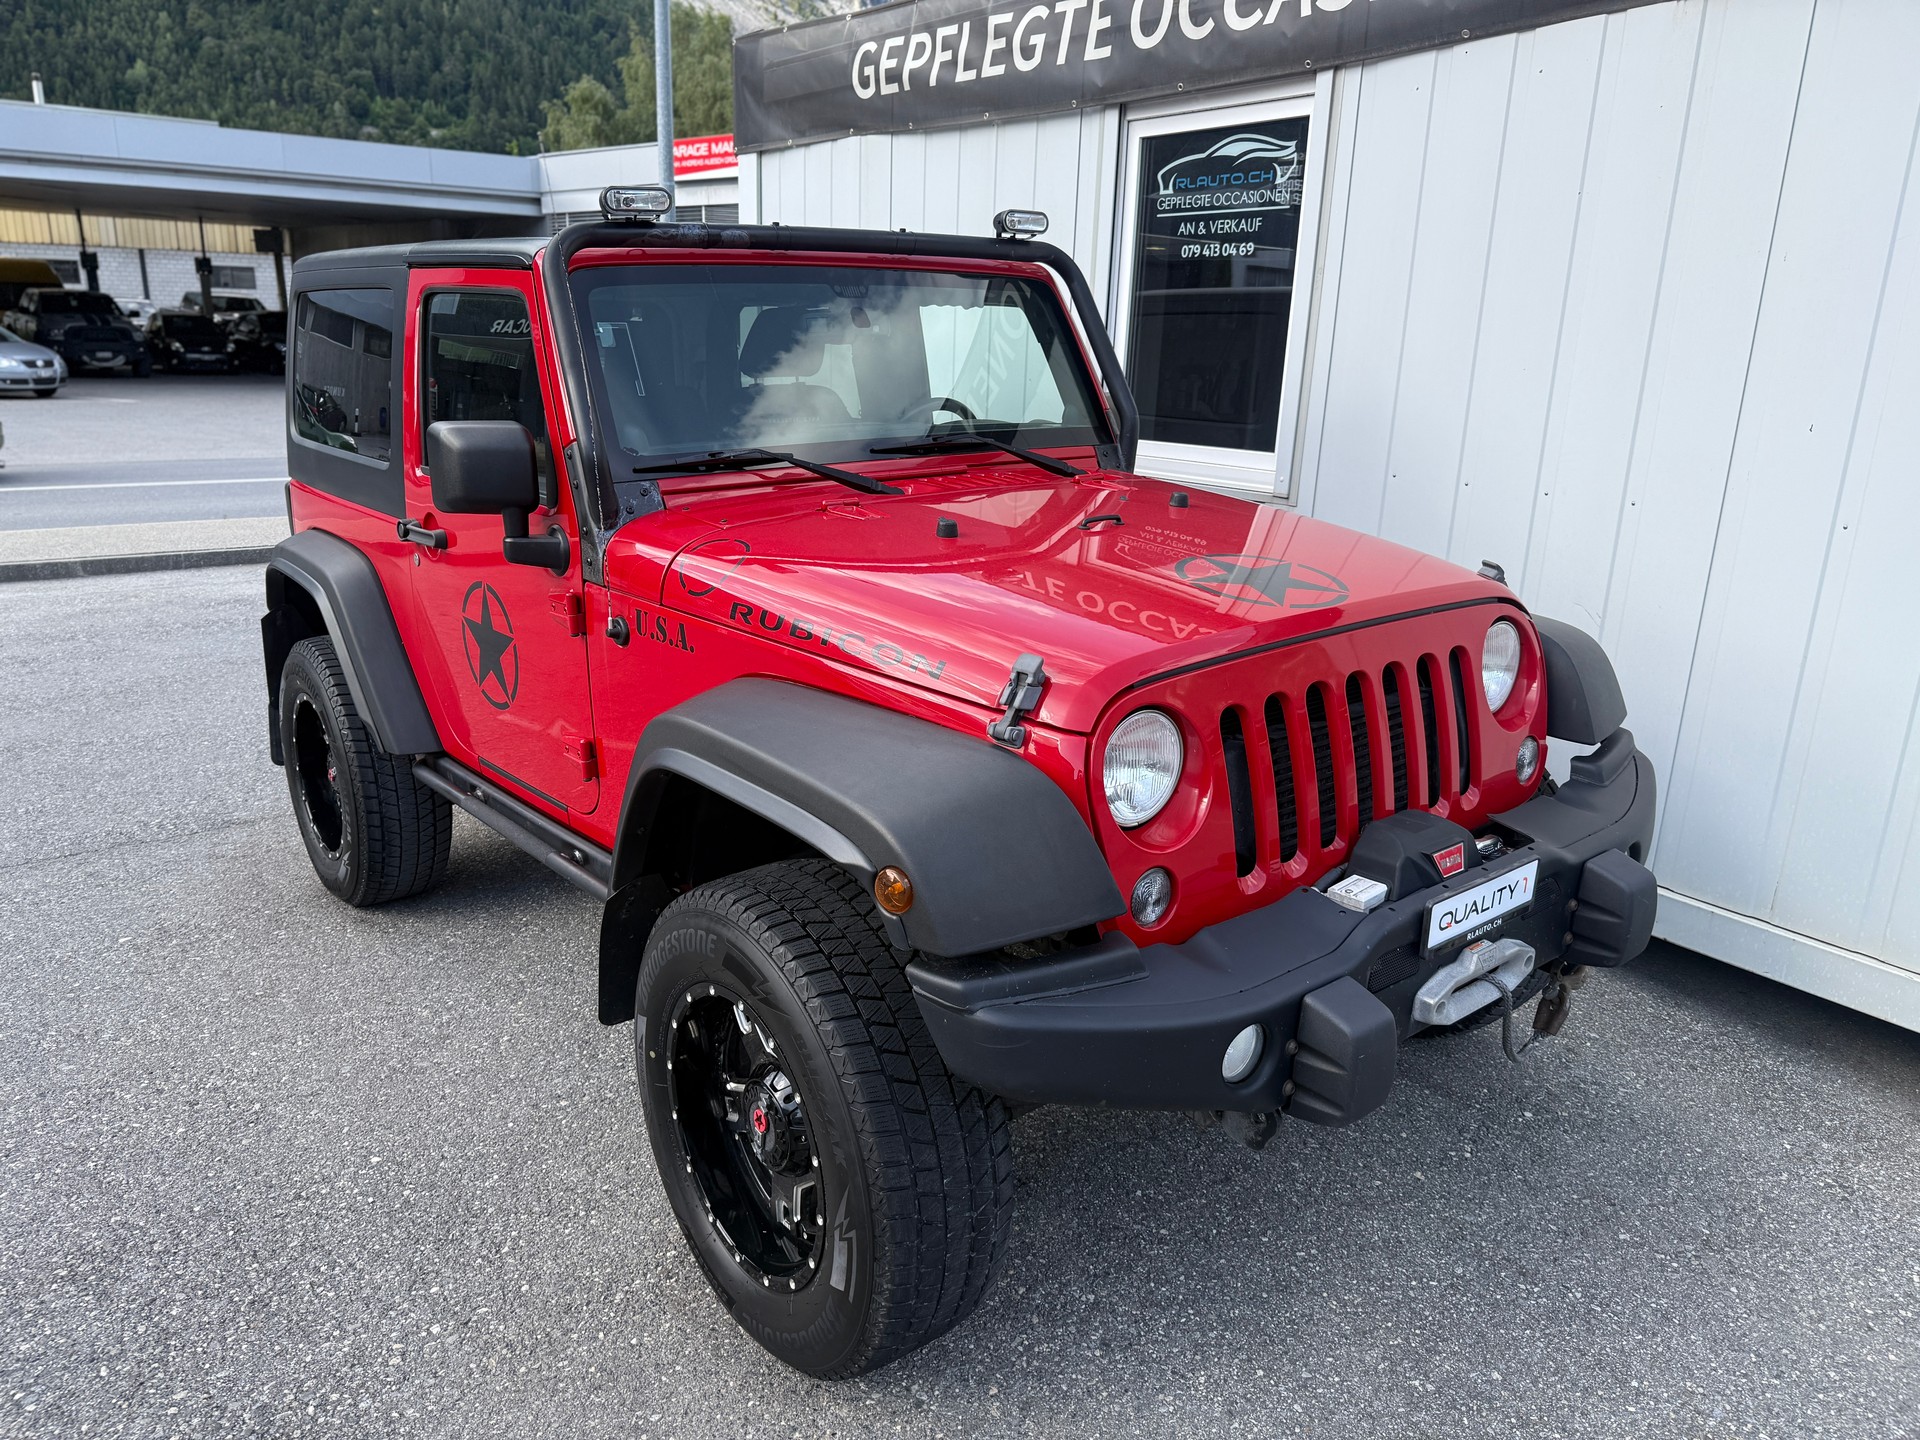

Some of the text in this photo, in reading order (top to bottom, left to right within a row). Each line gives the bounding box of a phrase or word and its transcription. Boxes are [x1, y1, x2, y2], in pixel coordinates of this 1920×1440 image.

[852, 0, 1352, 99] GEPFLEGTE OCC
[673, 143, 709, 158] ARAGE
[1175, 170, 1274, 190] RLAUTO.CH
[1156, 188, 1291, 210] GEPFLEGTE OCCASIONEN
[1177, 217, 1263, 236] AN & VERKAUF
[1181, 242, 1255, 258] 079 413 04 69
[634, 608, 696, 654] U.S.A.
[729, 602, 948, 681] RUBICON
[1438, 879, 1520, 932] QUALITY
[1466, 917, 1502, 941] RLAUTO.CH
[638, 928, 718, 1011] BRIDGESTONE
